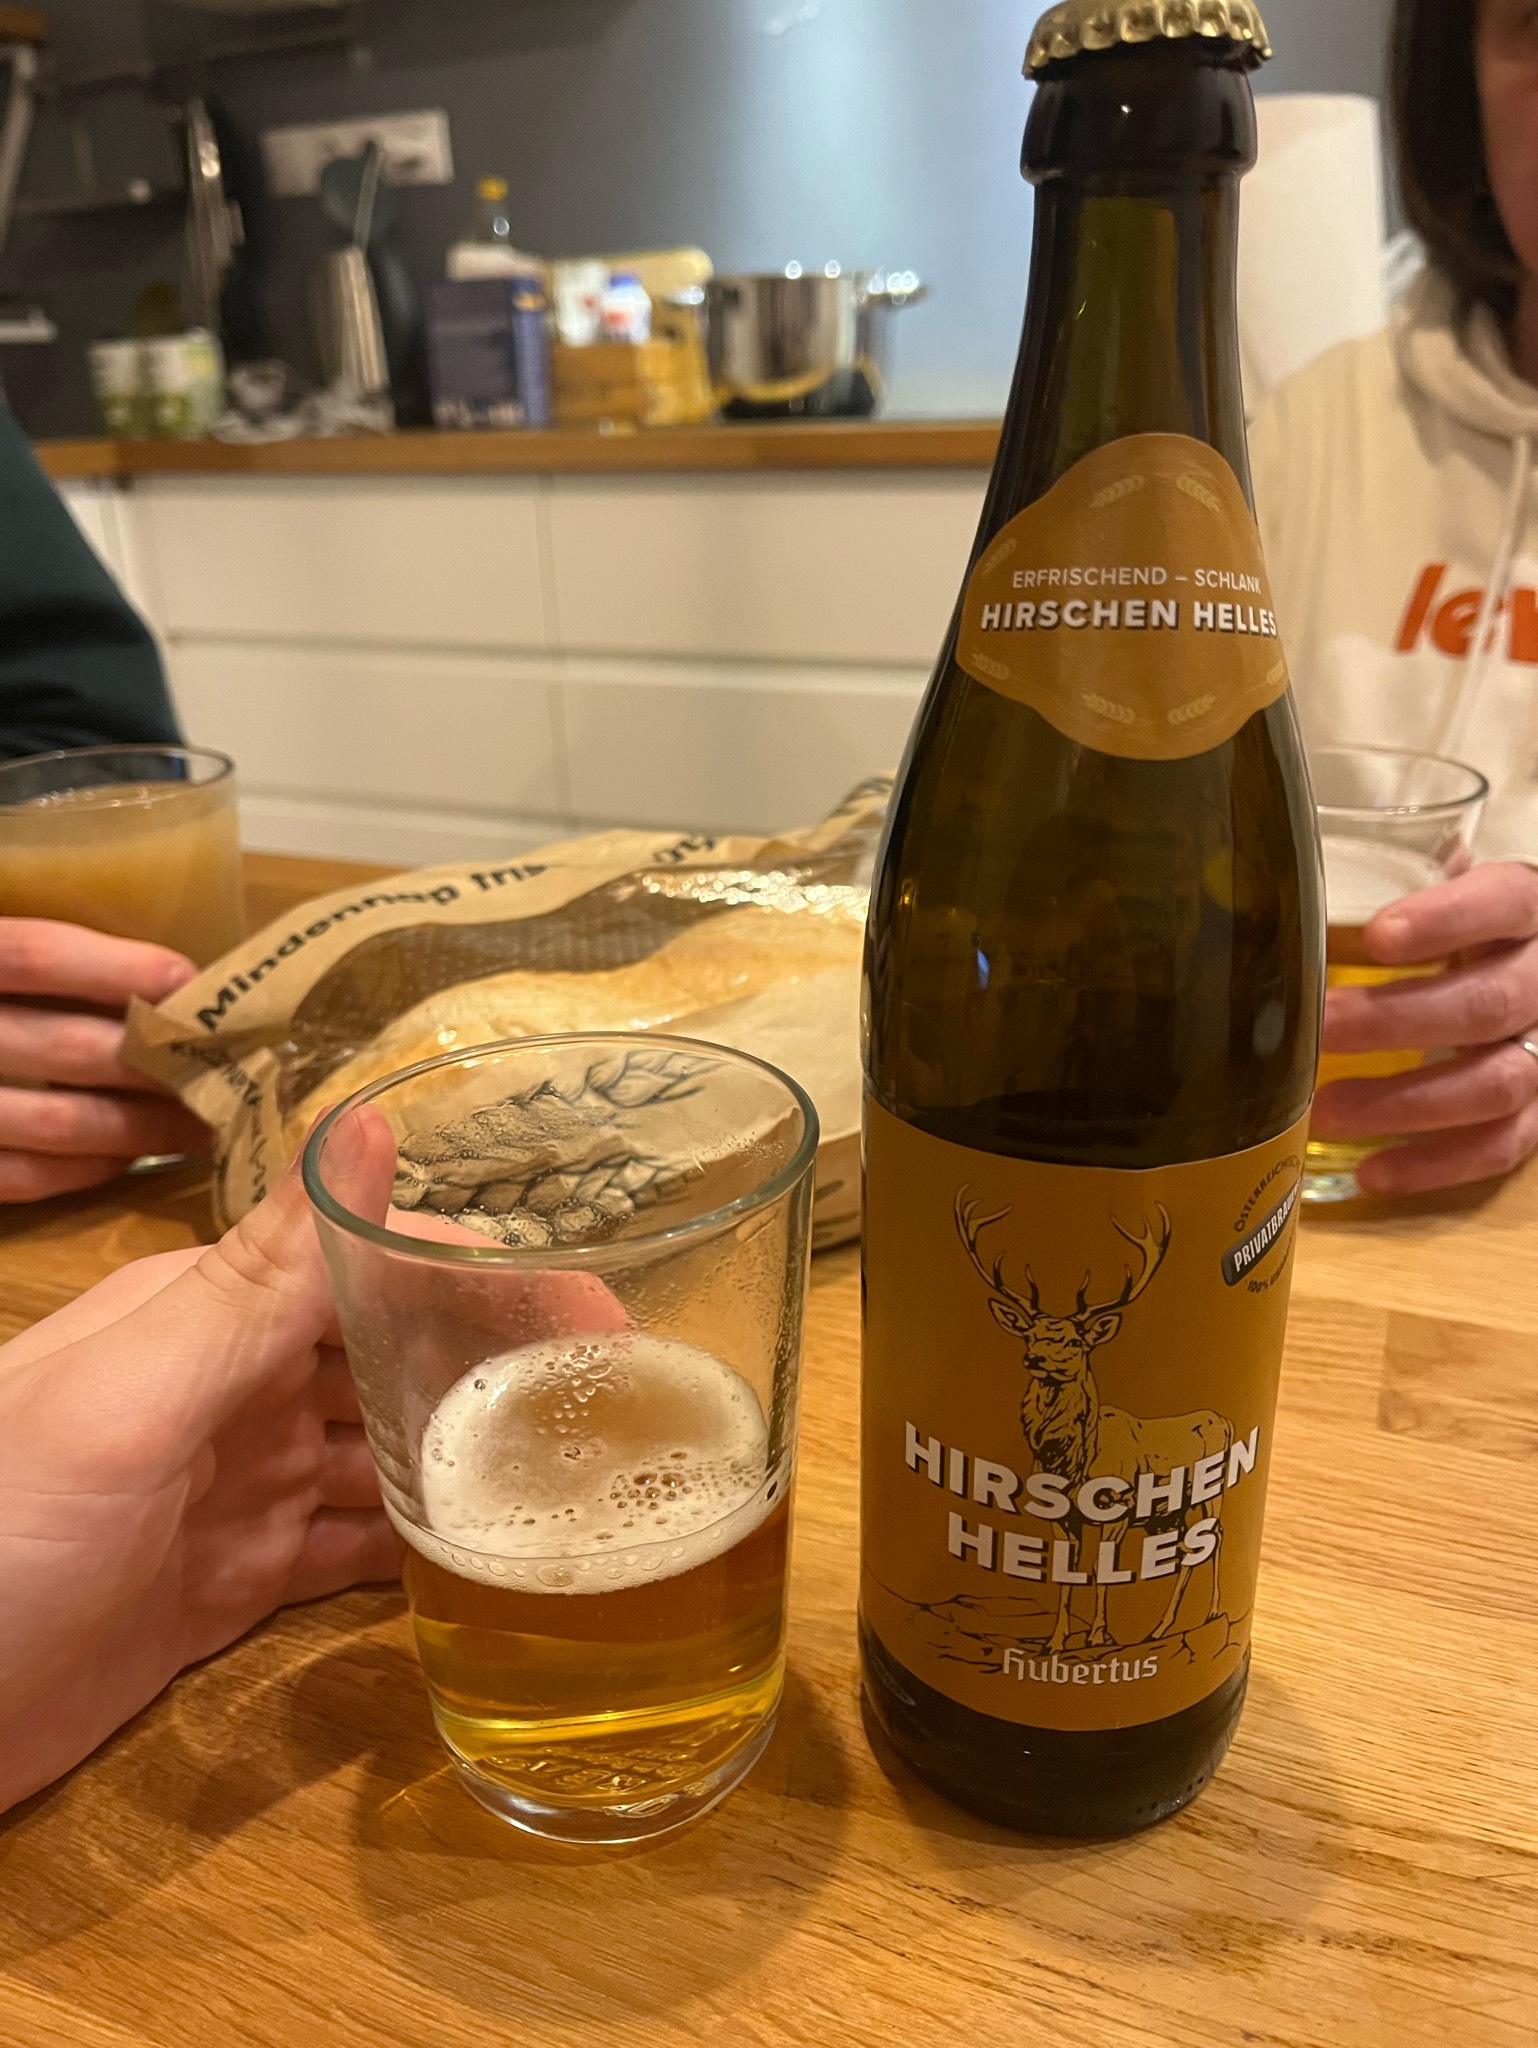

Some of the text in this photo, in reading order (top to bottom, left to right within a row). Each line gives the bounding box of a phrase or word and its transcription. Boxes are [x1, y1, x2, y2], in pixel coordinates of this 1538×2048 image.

[1013, 566, 1167, 589] ERFRISCHEND
[1194, 569, 1262, 595] SCHLANK
[981, 599, 1277, 636] HIRSCHEN HELLES
[905, 1420, 1260, 1522] HIRSCHEN
[948, 1511, 1222, 1586] HELLES
